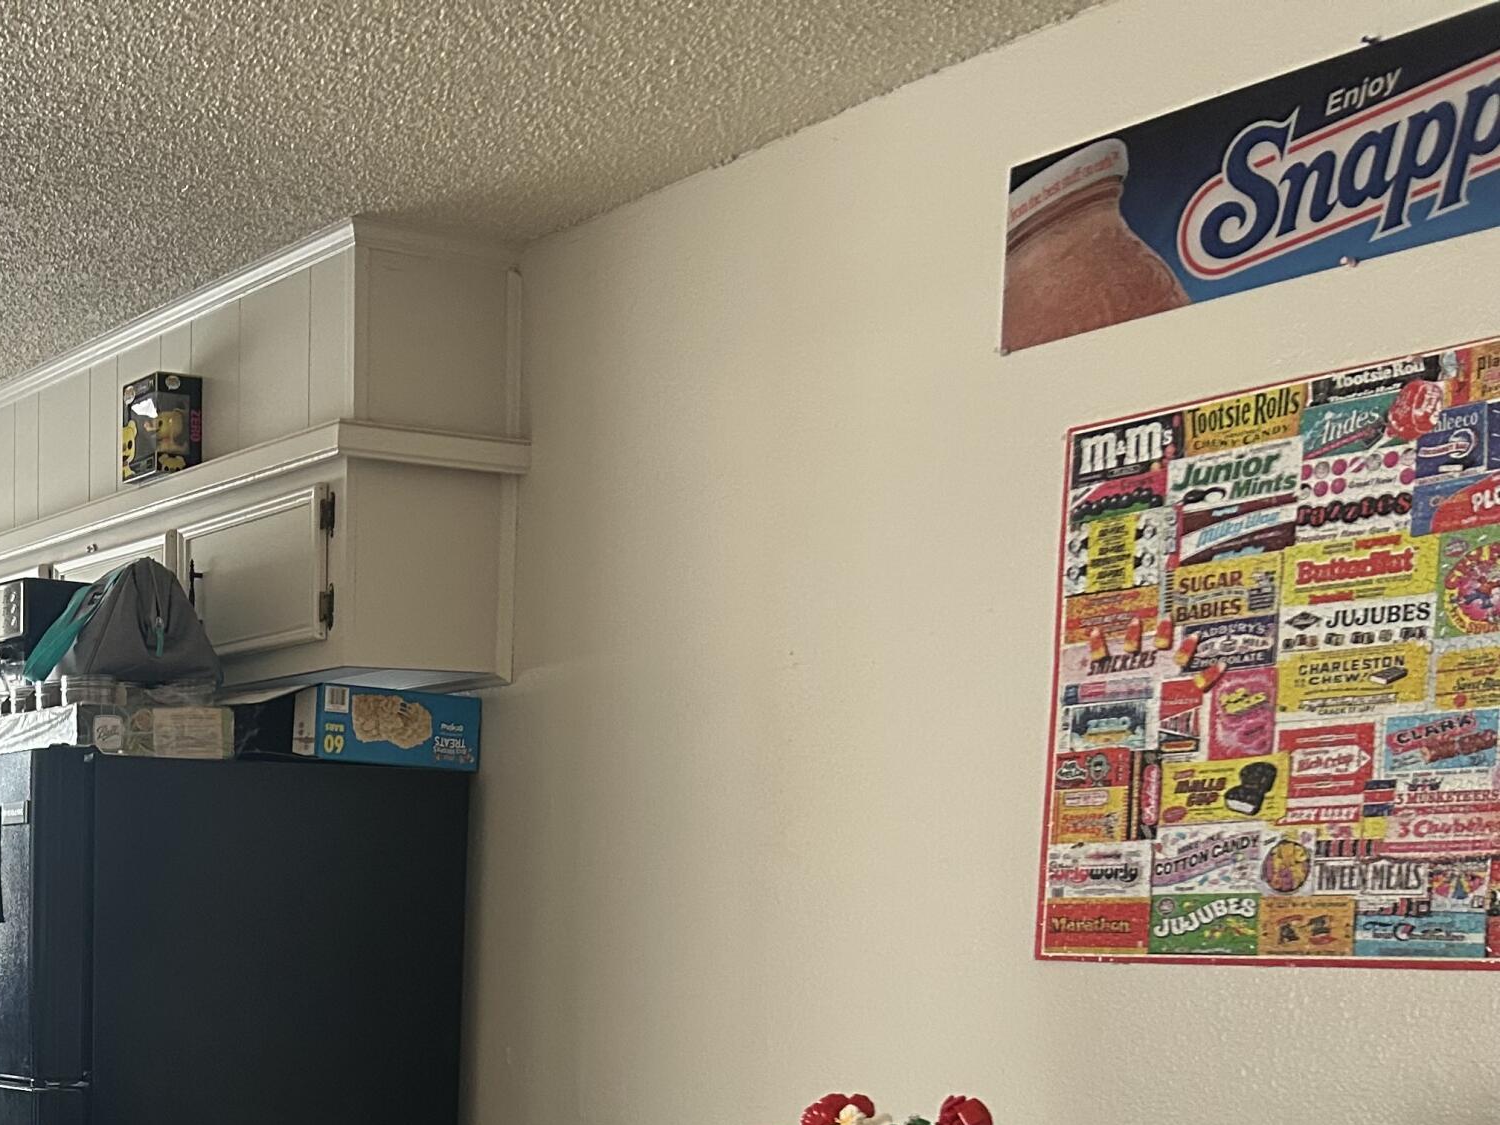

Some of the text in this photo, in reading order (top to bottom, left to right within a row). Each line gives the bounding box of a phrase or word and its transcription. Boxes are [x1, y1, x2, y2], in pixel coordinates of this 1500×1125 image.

[1324, 67, 1402, 116] Enjoy
[1198, 74, 1500, 260] Snapp
[1188, 401, 1251, 438] Tootsie
[1253, 387, 1300, 426] Rolls
[1316, 405, 1380, 445] Andes
[1171, 453, 1281, 491] Junior
[1229, 473, 1297, 499] Mints
[1179, 570, 1244, 595] SUGAR
[1176, 598, 1242, 622] BABIES
[1325, 602, 1431, 629] JUJUBES
[1299, 655, 1406, 676] CHARLESTON
[323, 734, 345, 754] 60
[434, 735, 466, 749] TREATS
[1154, 834, 1262, 877] COTTON CANDY
[1052, 915, 1131, 934] Marathon
[1153, 898, 1257, 937] JUJUBES
